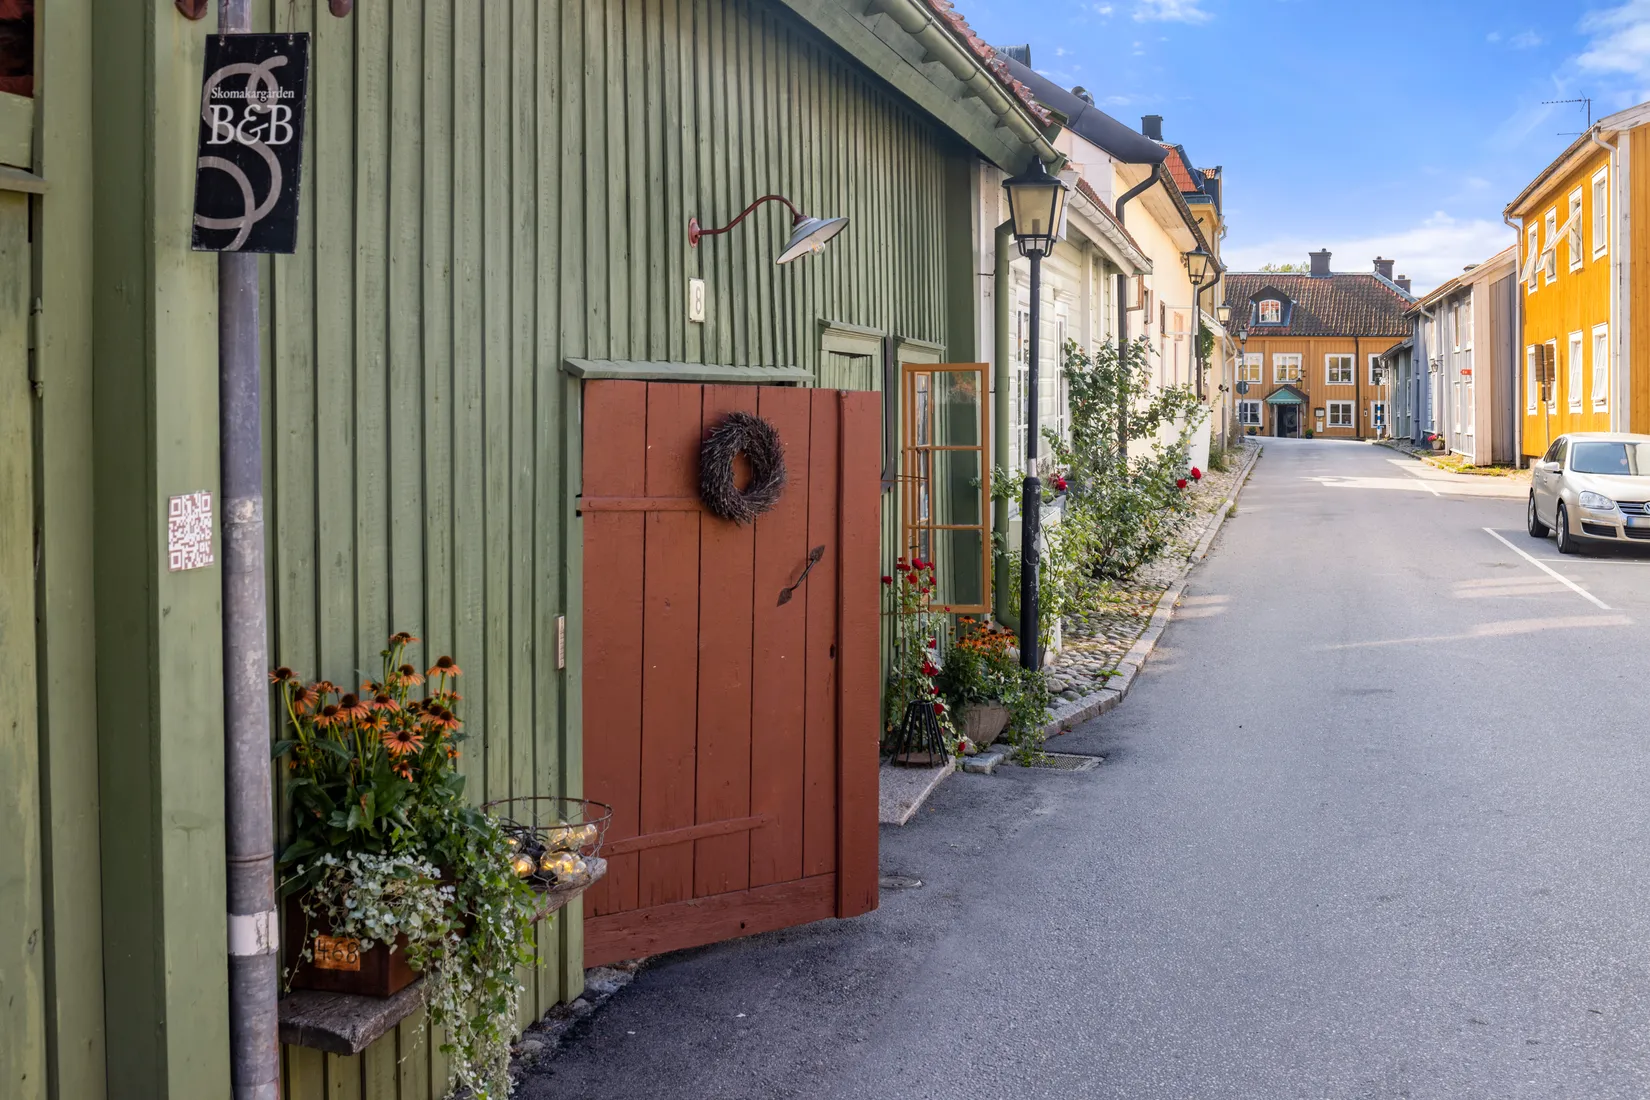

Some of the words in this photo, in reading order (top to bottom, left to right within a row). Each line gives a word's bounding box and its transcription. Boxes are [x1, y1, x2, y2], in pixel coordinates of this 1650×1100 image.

[211, 86, 295, 102] Skomakargården
[206, 104, 294, 145] B&B
[695, 286, 702, 315] 8
